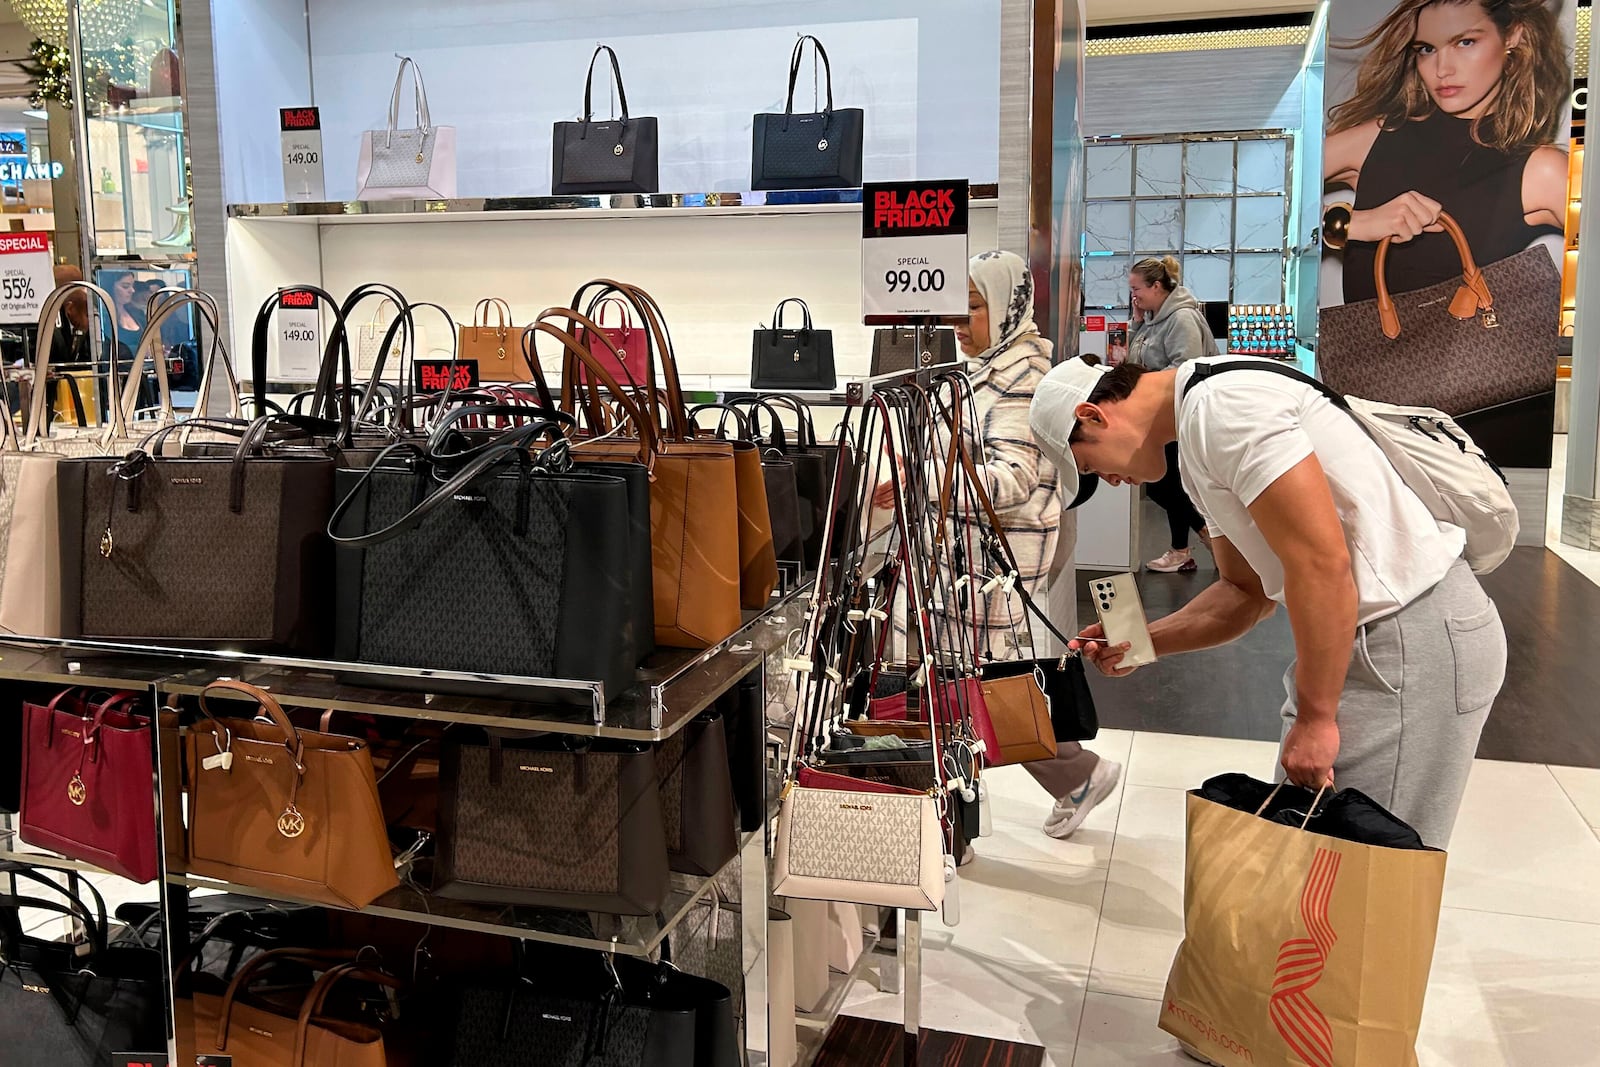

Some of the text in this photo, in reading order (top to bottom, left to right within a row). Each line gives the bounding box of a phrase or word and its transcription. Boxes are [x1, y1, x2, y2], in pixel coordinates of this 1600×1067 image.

[284, 110, 315, 120] BLACK
[284, 118, 315, 127] FRIDAY
[287, 152, 318, 164] 149.00
[874, 189, 955, 209] BLACK
[874, 208, 955, 228] FRIDAY
[897, 257, 929, 265] SPECIAL
[885, 268, 945, 293] 99.00
[2, 277, 35, 300] 55%
[9, 302, 26, 311] Original
[27, 301, 38, 309] Price
[283, 297, 314, 306] FRIDAY
[284, 330, 315, 341] 149.00
